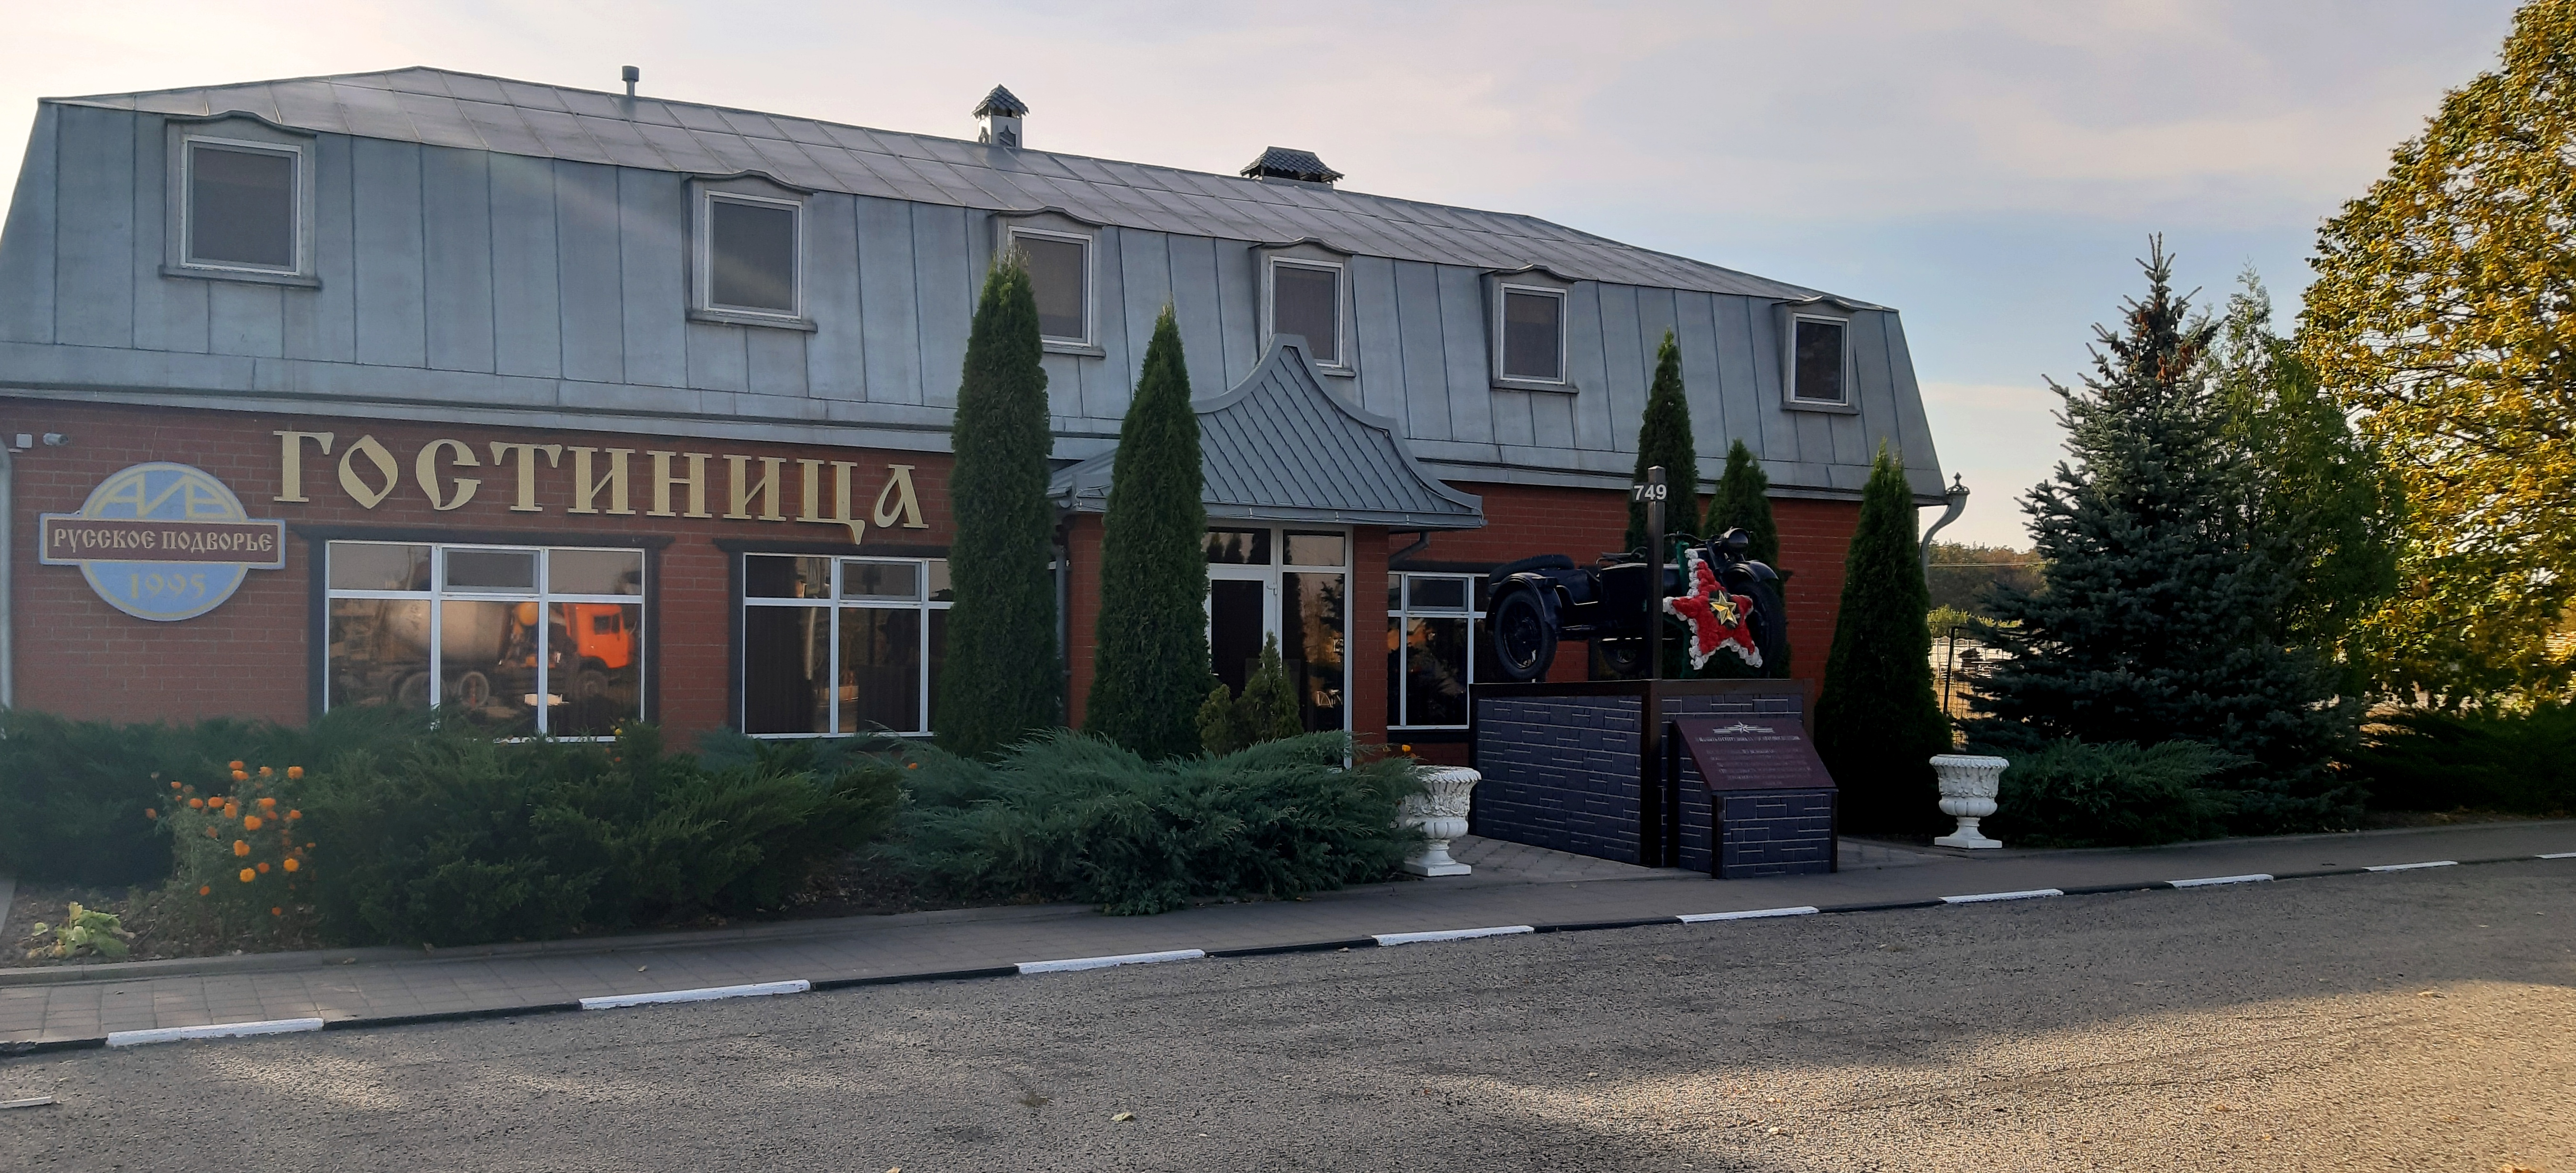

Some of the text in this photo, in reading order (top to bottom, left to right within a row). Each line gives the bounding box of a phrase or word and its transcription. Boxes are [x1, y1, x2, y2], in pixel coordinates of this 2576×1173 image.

[273, 429, 930, 545] ГОСТИНИЦА
[1633, 484, 1667, 501] 749
[53, 528, 273, 554] РУССКОЕ ПОДВОРЬЕ
[129, 573, 206, 599] 1995
